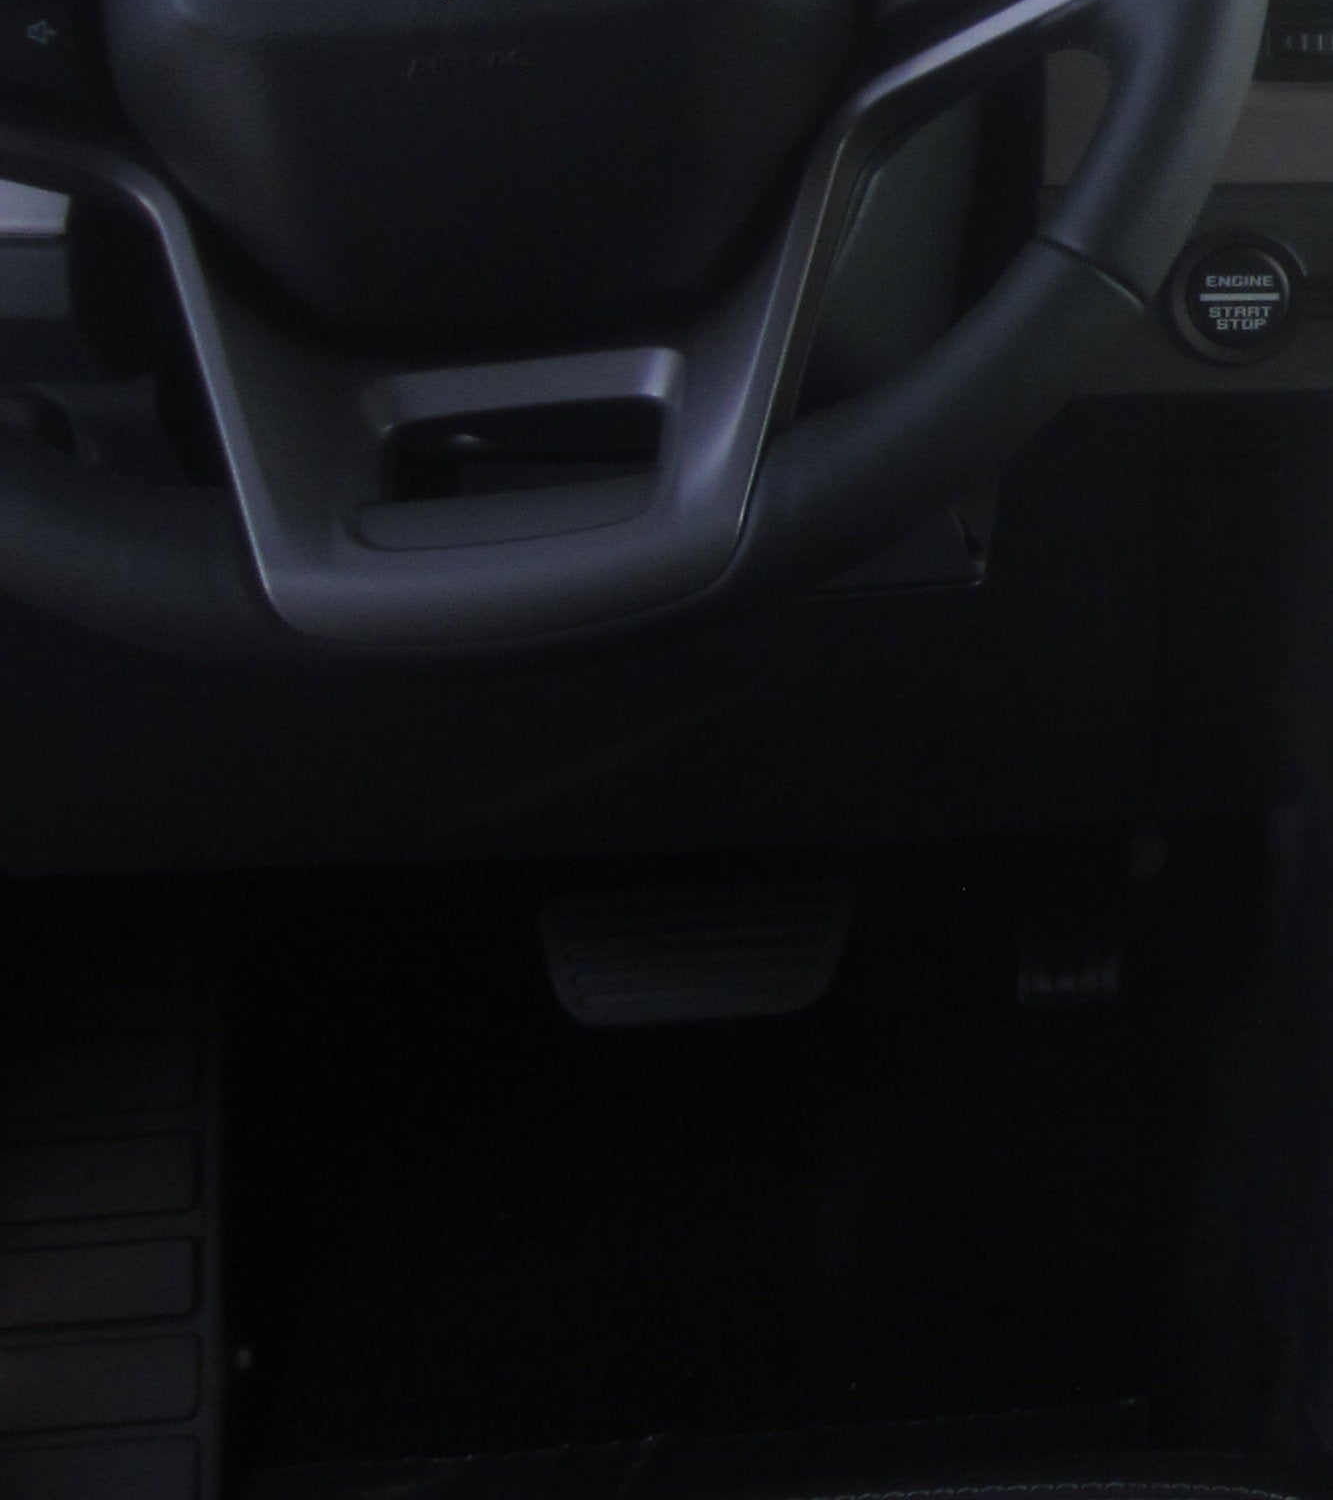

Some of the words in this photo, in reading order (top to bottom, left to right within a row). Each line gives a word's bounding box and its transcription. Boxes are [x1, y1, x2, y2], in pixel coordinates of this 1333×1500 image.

[1206, 275, 1274, 287] ENGINE
[1209, 306, 1272, 318] START
[1216, 318, 1267, 330] STOP
